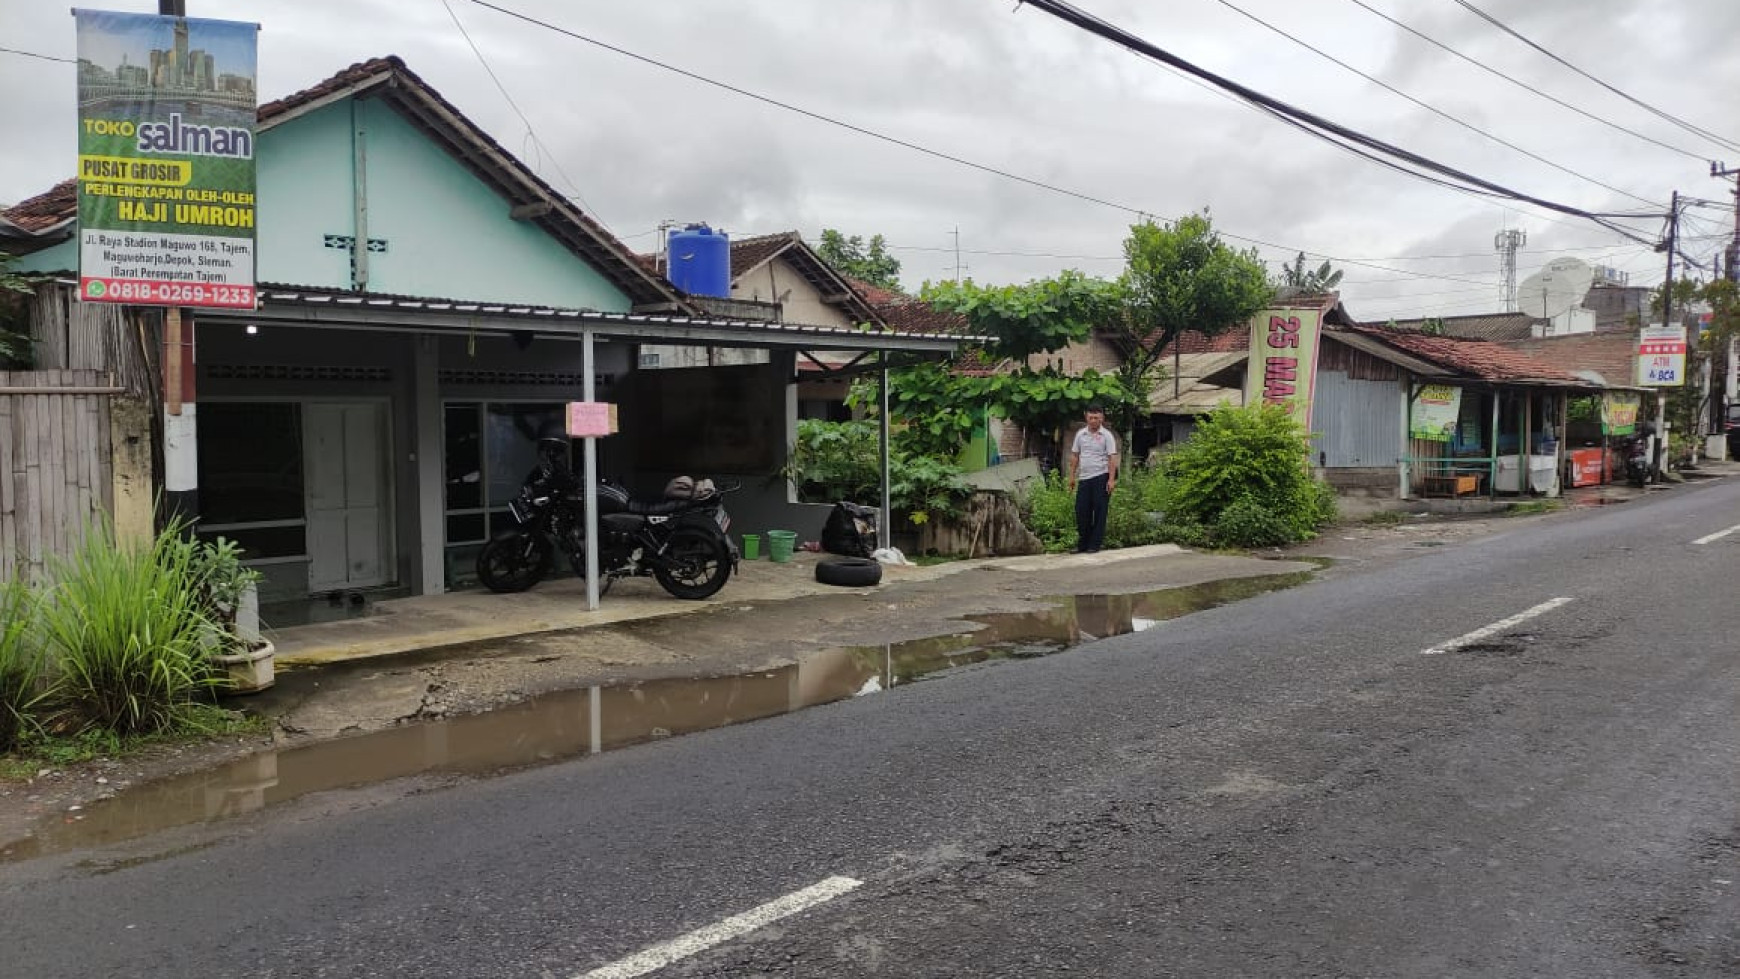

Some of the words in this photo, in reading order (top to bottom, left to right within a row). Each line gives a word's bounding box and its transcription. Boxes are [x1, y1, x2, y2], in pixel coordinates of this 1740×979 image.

[84, 119, 135, 137] TOKO
[137, 113, 253, 159] salman
[83, 159, 128, 179] PUSAT
[131, 163, 181, 182] GROSIR
[85, 183, 183, 200] PERLENGKAPAN
[186, 189, 254, 206] OLEH-OLEH
[118, 201, 168, 223] HAJI
[175, 204, 254, 228] UMROH
[99, 235, 122, 249] Raya
[125, 237, 158, 250] Stadion
[161, 239, 197, 253] Maguwo
[141, 268, 194, 281] Perempatan
[196, 270, 227, 283] Tajem)
[109, 282, 250, 305] 0818-0269-1233
[1267, 316, 1302, 349] 25
[1652, 356, 1671, 367] ATM
